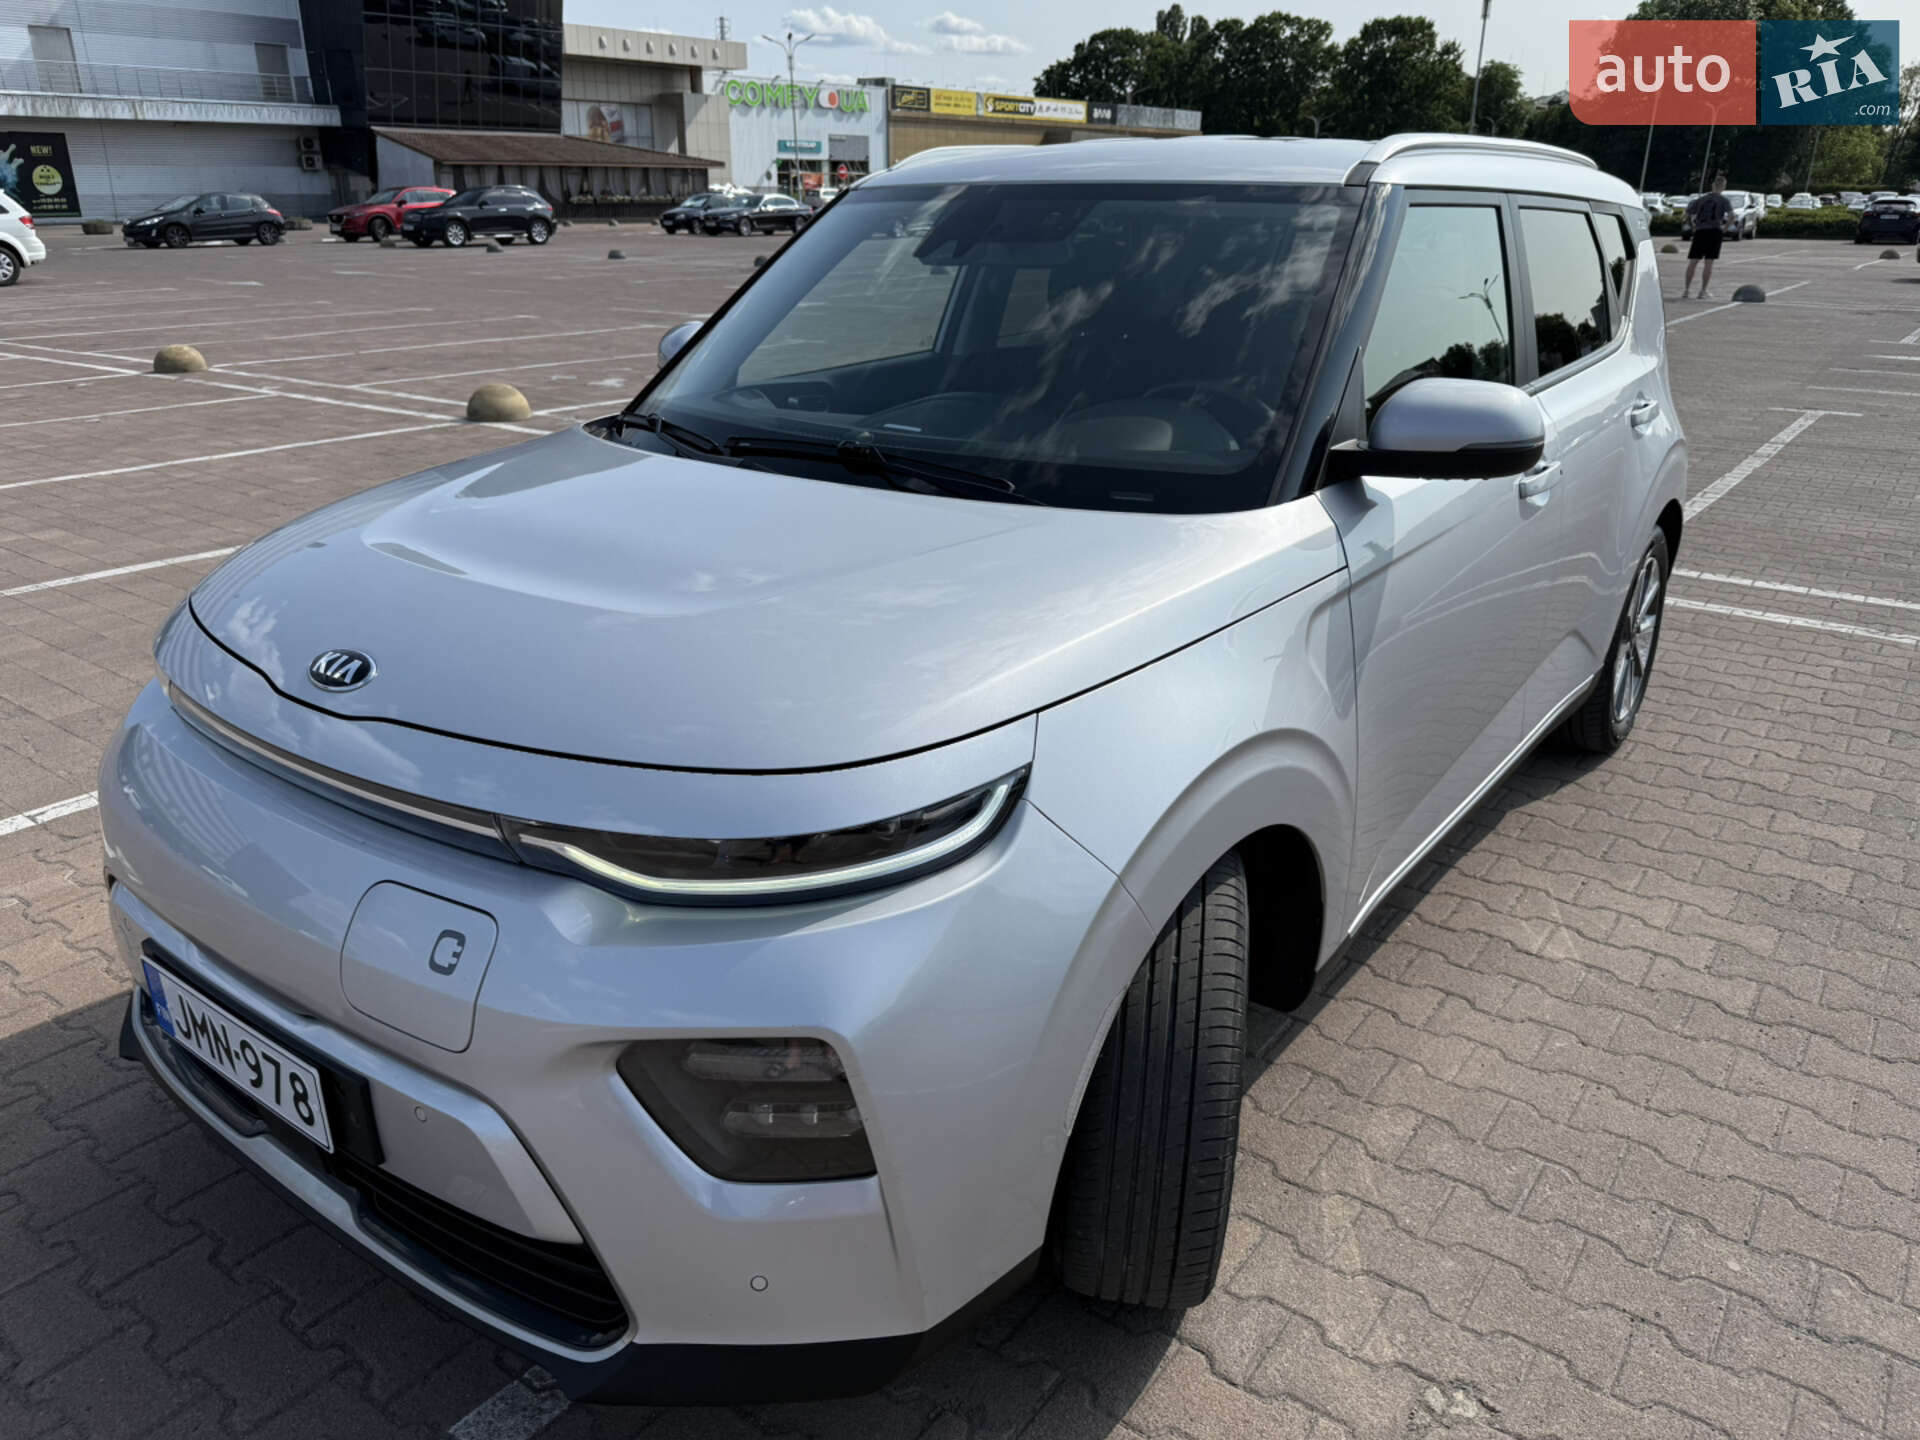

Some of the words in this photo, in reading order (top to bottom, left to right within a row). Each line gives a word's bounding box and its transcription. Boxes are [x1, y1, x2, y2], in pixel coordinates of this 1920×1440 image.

[725, 79, 820, 110] COMFY
[311, 651, 363, 684] KIA
[174, 994, 316, 1127] JMN-978
